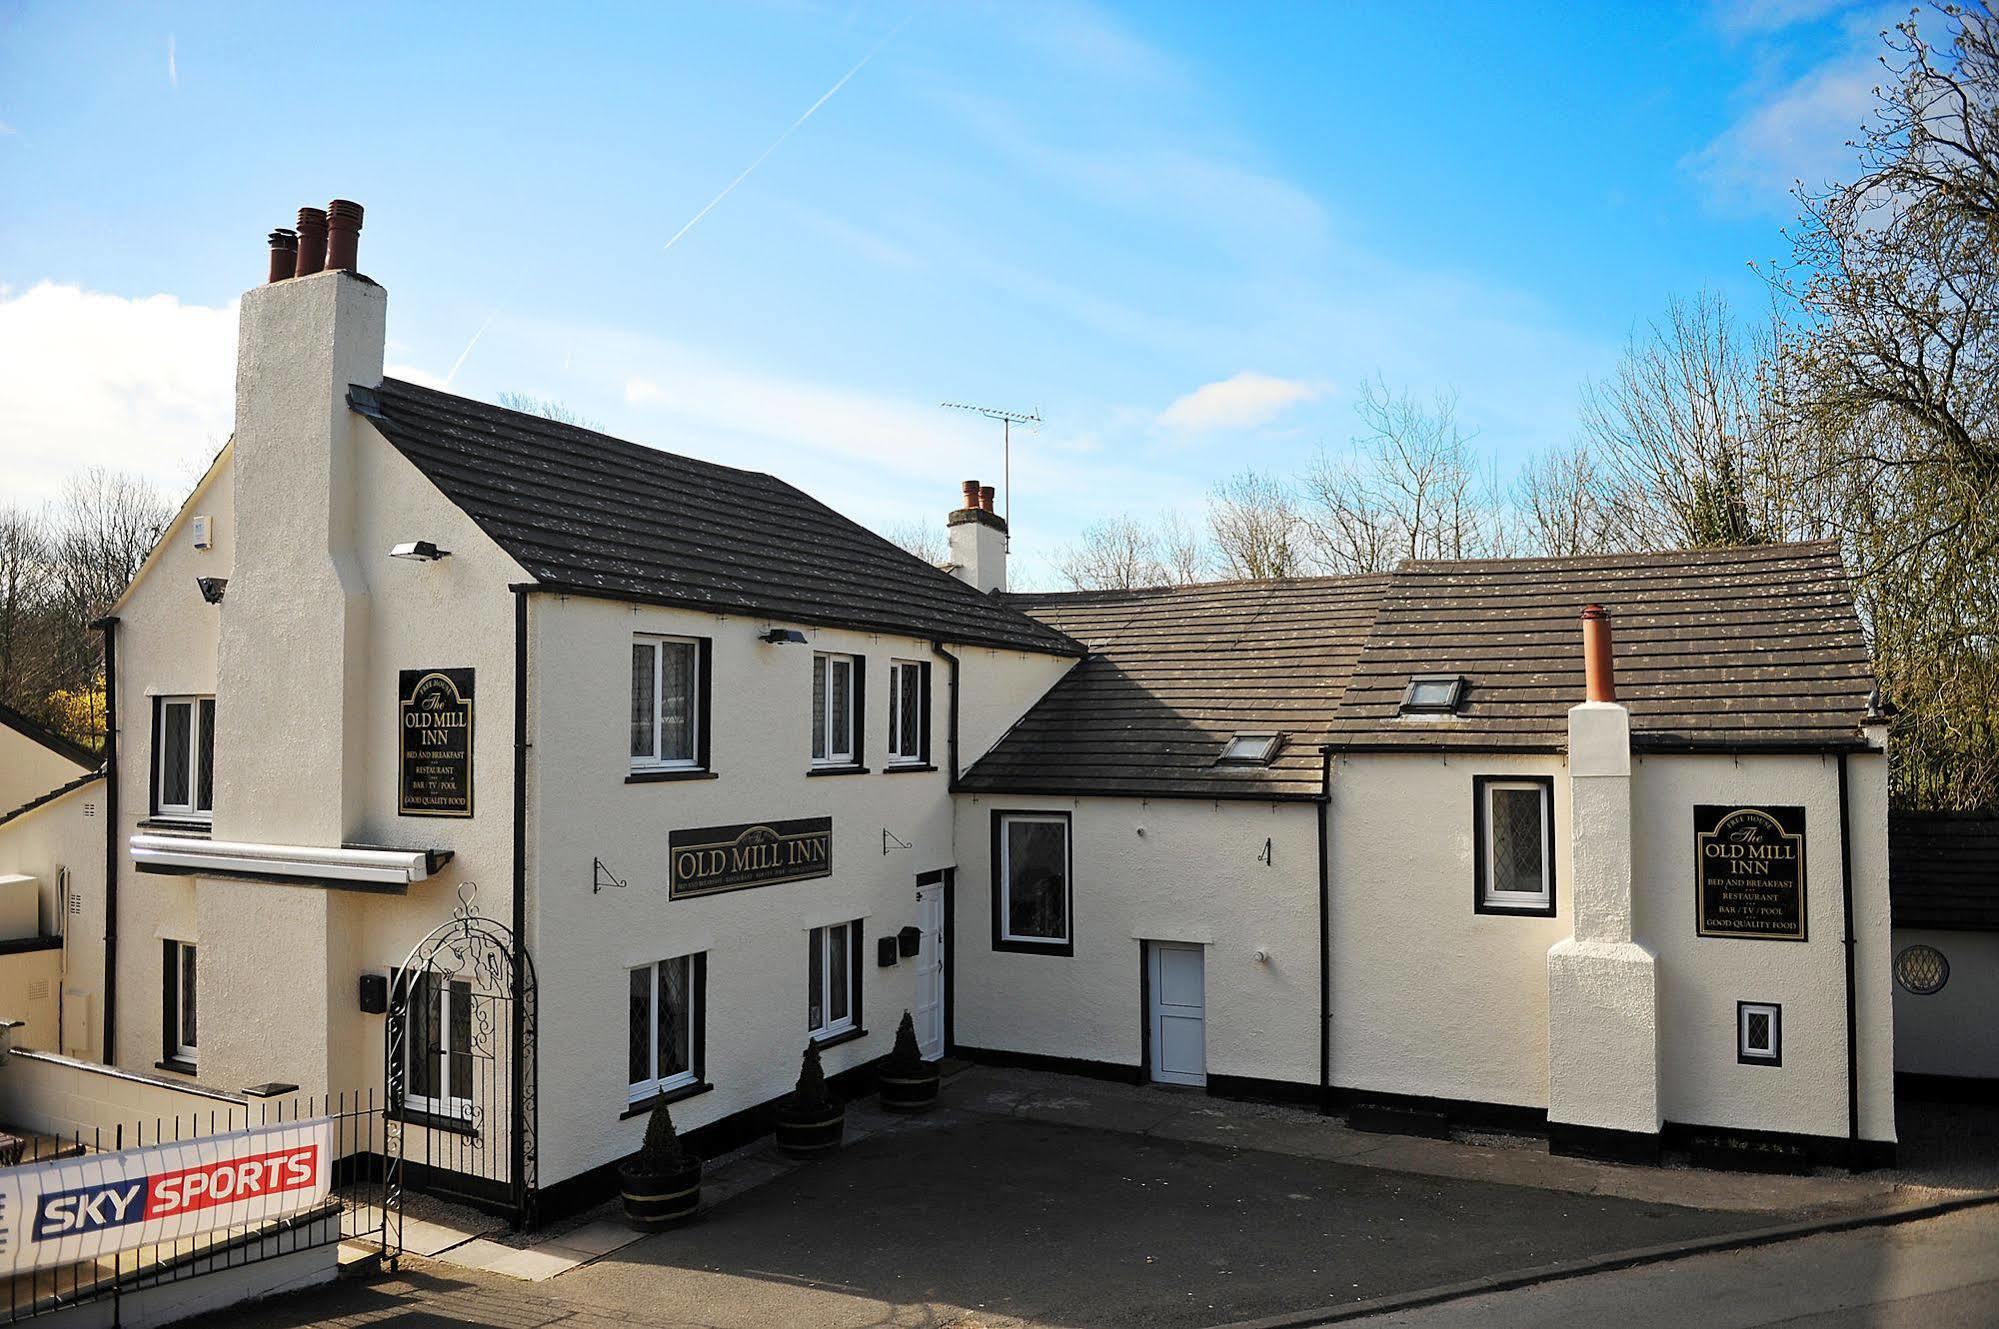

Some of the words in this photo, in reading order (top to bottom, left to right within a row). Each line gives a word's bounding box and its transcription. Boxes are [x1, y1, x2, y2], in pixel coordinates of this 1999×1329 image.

[422, 693, 445, 710] The
[405, 712, 432, 728] OLD
[434, 712, 467, 728] MILL
[422, 730, 449, 745] INN
[418, 751, 431, 759] AND
[431, 751, 464, 759] BREAKFAST
[416, 766, 455, 774] RESTAURANT
[413, 781, 425, 789] BAR
[429, 781, 437, 789] TV
[441, 782, 457, 790] POOL
[422, 796, 448, 805] QUALITY
[448, 797, 466, 805] FOOD
[1726, 815, 1744, 829] FREE
[1747, 815, 1773, 829] HOUSE
[1730, 826, 1763, 843] The
[678, 850, 726, 880] OLD
[731, 843, 784, 873] MILL
[788, 837, 827, 865] INN
[1705, 843, 1744, 858] OLD
[1749, 844, 1796, 860] MILL
[1730, 859, 1769, 875] INN
[1708, 878, 1723, 886] BED
[1725, 879, 1745, 887] AND
[1746, 879, 1793, 888] BREAKFAST
[1722, 892, 1779, 901] RESTAURANT
[1719, 906, 1736, 914] BAR
[1743, 906, 1754, 914] TV
[1761, 907, 1783, 915] POOL
[1706, 918, 1732, 927] GOOD
[1733, 919, 1771, 928] QUALITY
[1772, 921, 1797, 929] FOOD
[41, 1183, 141, 1236] SKY
[151, 1150, 313, 1214] SPORTS
